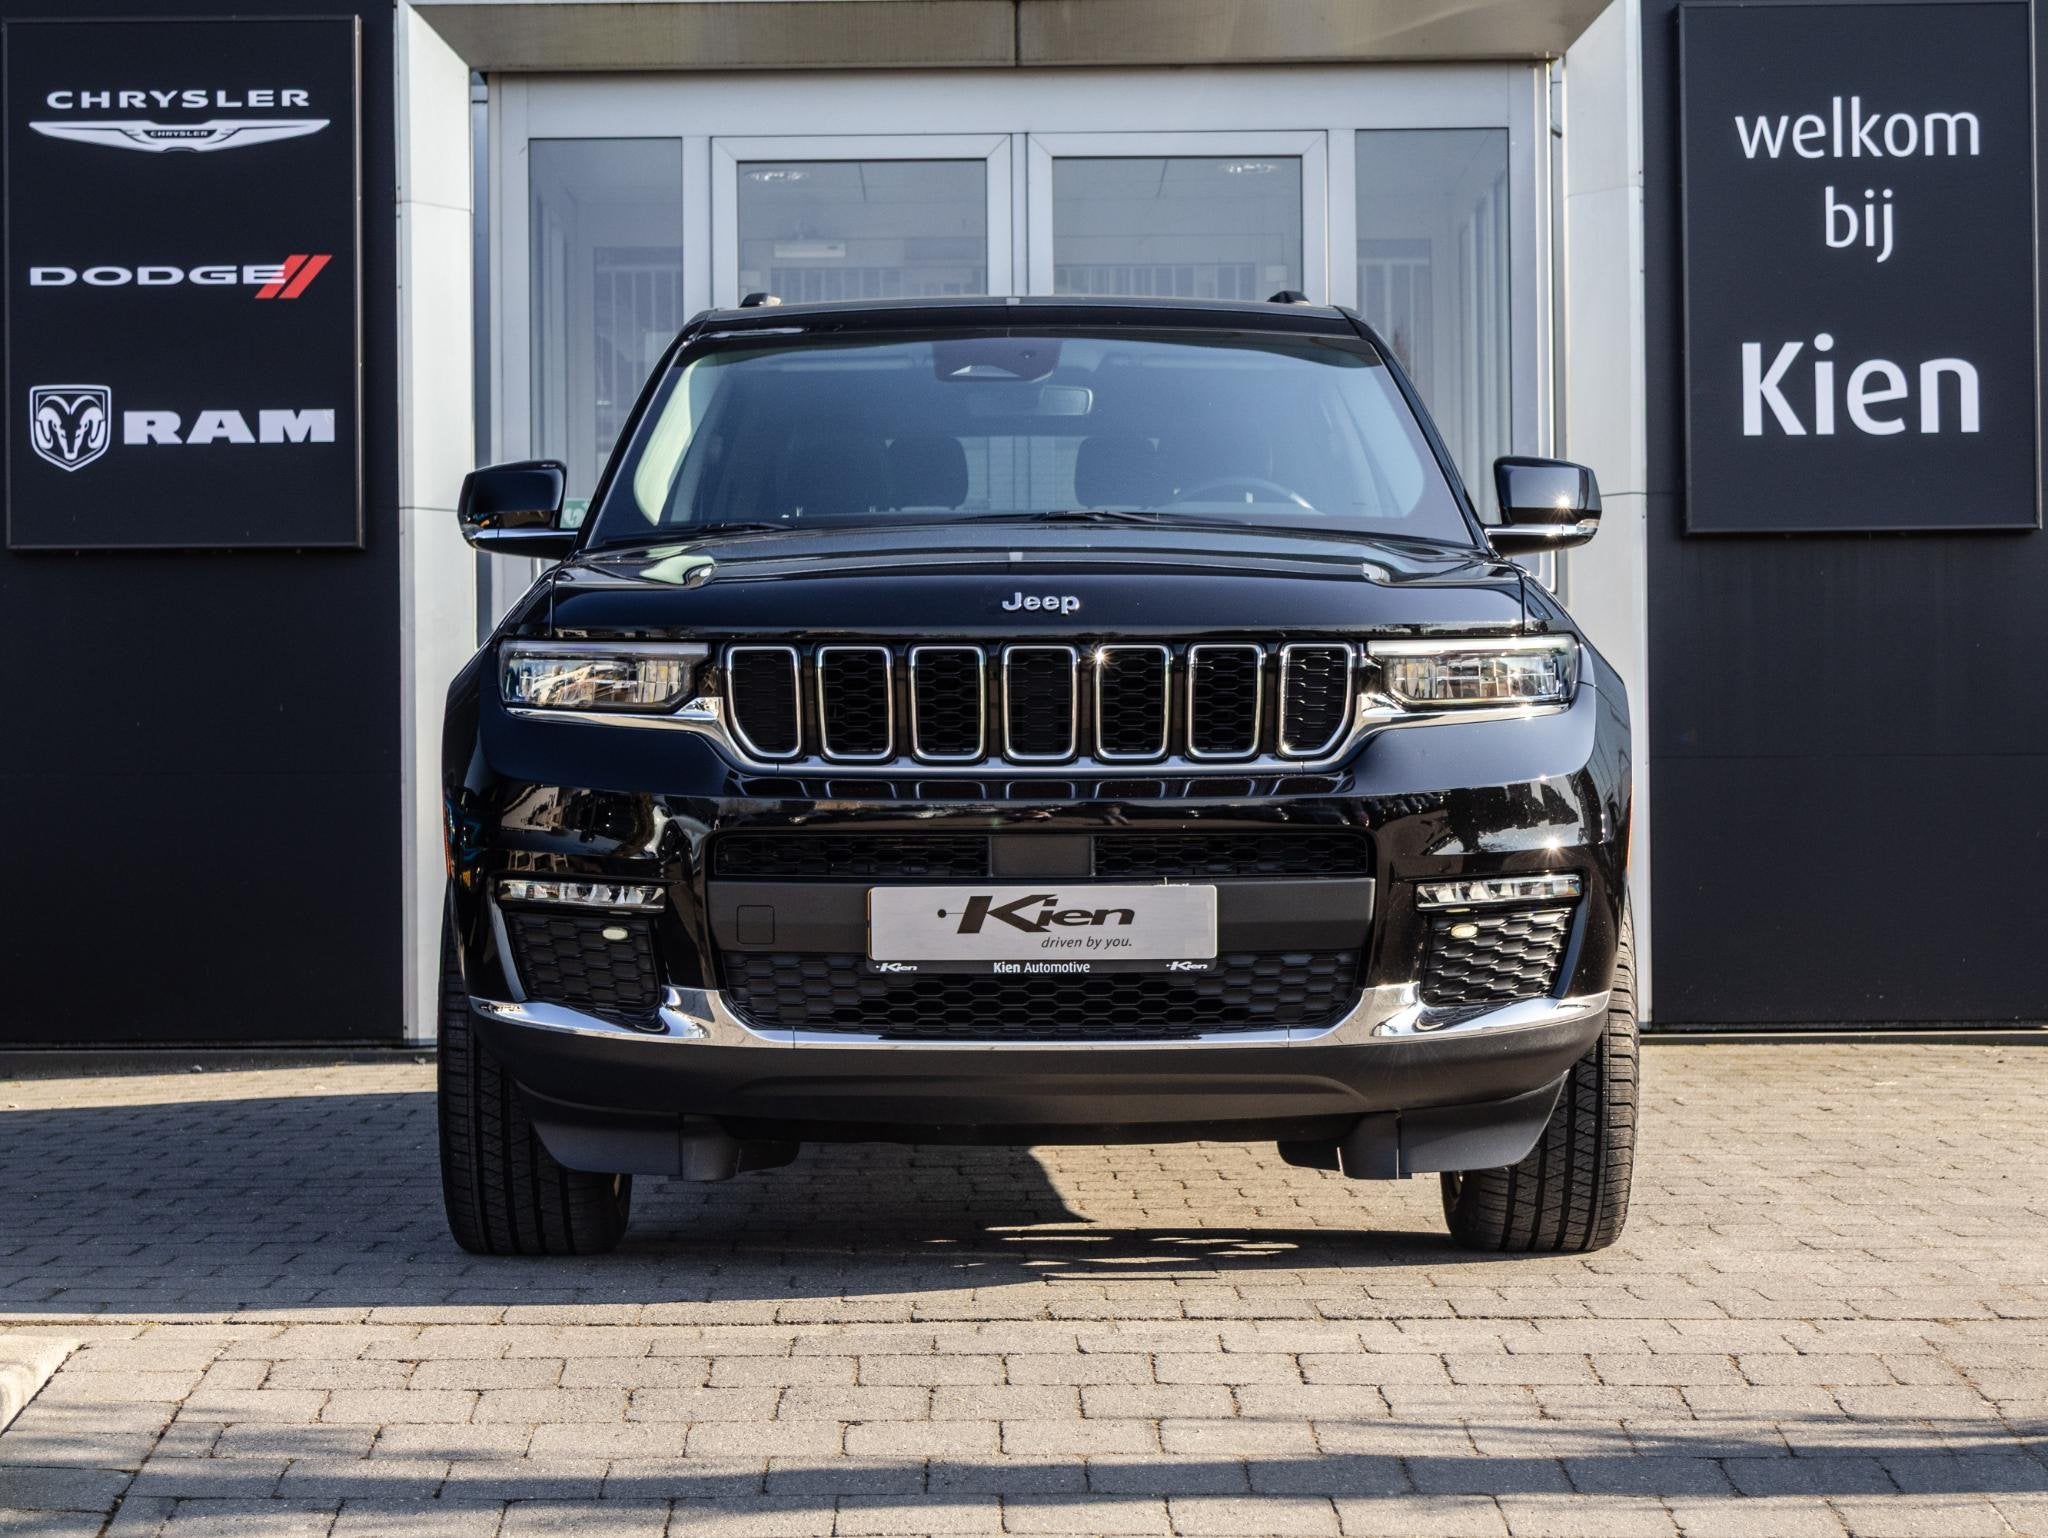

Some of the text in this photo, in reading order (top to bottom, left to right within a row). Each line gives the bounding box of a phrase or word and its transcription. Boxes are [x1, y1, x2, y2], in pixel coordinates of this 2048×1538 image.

[47, 89, 310, 109] CHRYSLER
[1735, 96, 1980, 159] welkom
[1825, 186, 1894, 263] bij
[29, 265, 286, 286] DODGE
[1741, 333, 1980, 436] Kien
[123, 409, 335, 444] RAM
[1002, 591, 1080, 615] Jeep
[957, 894, 1135, 934] Kien
[1041, 936, 1132, 950] driven by you.
[993, 961, 1090, 973] Kien Automotive
